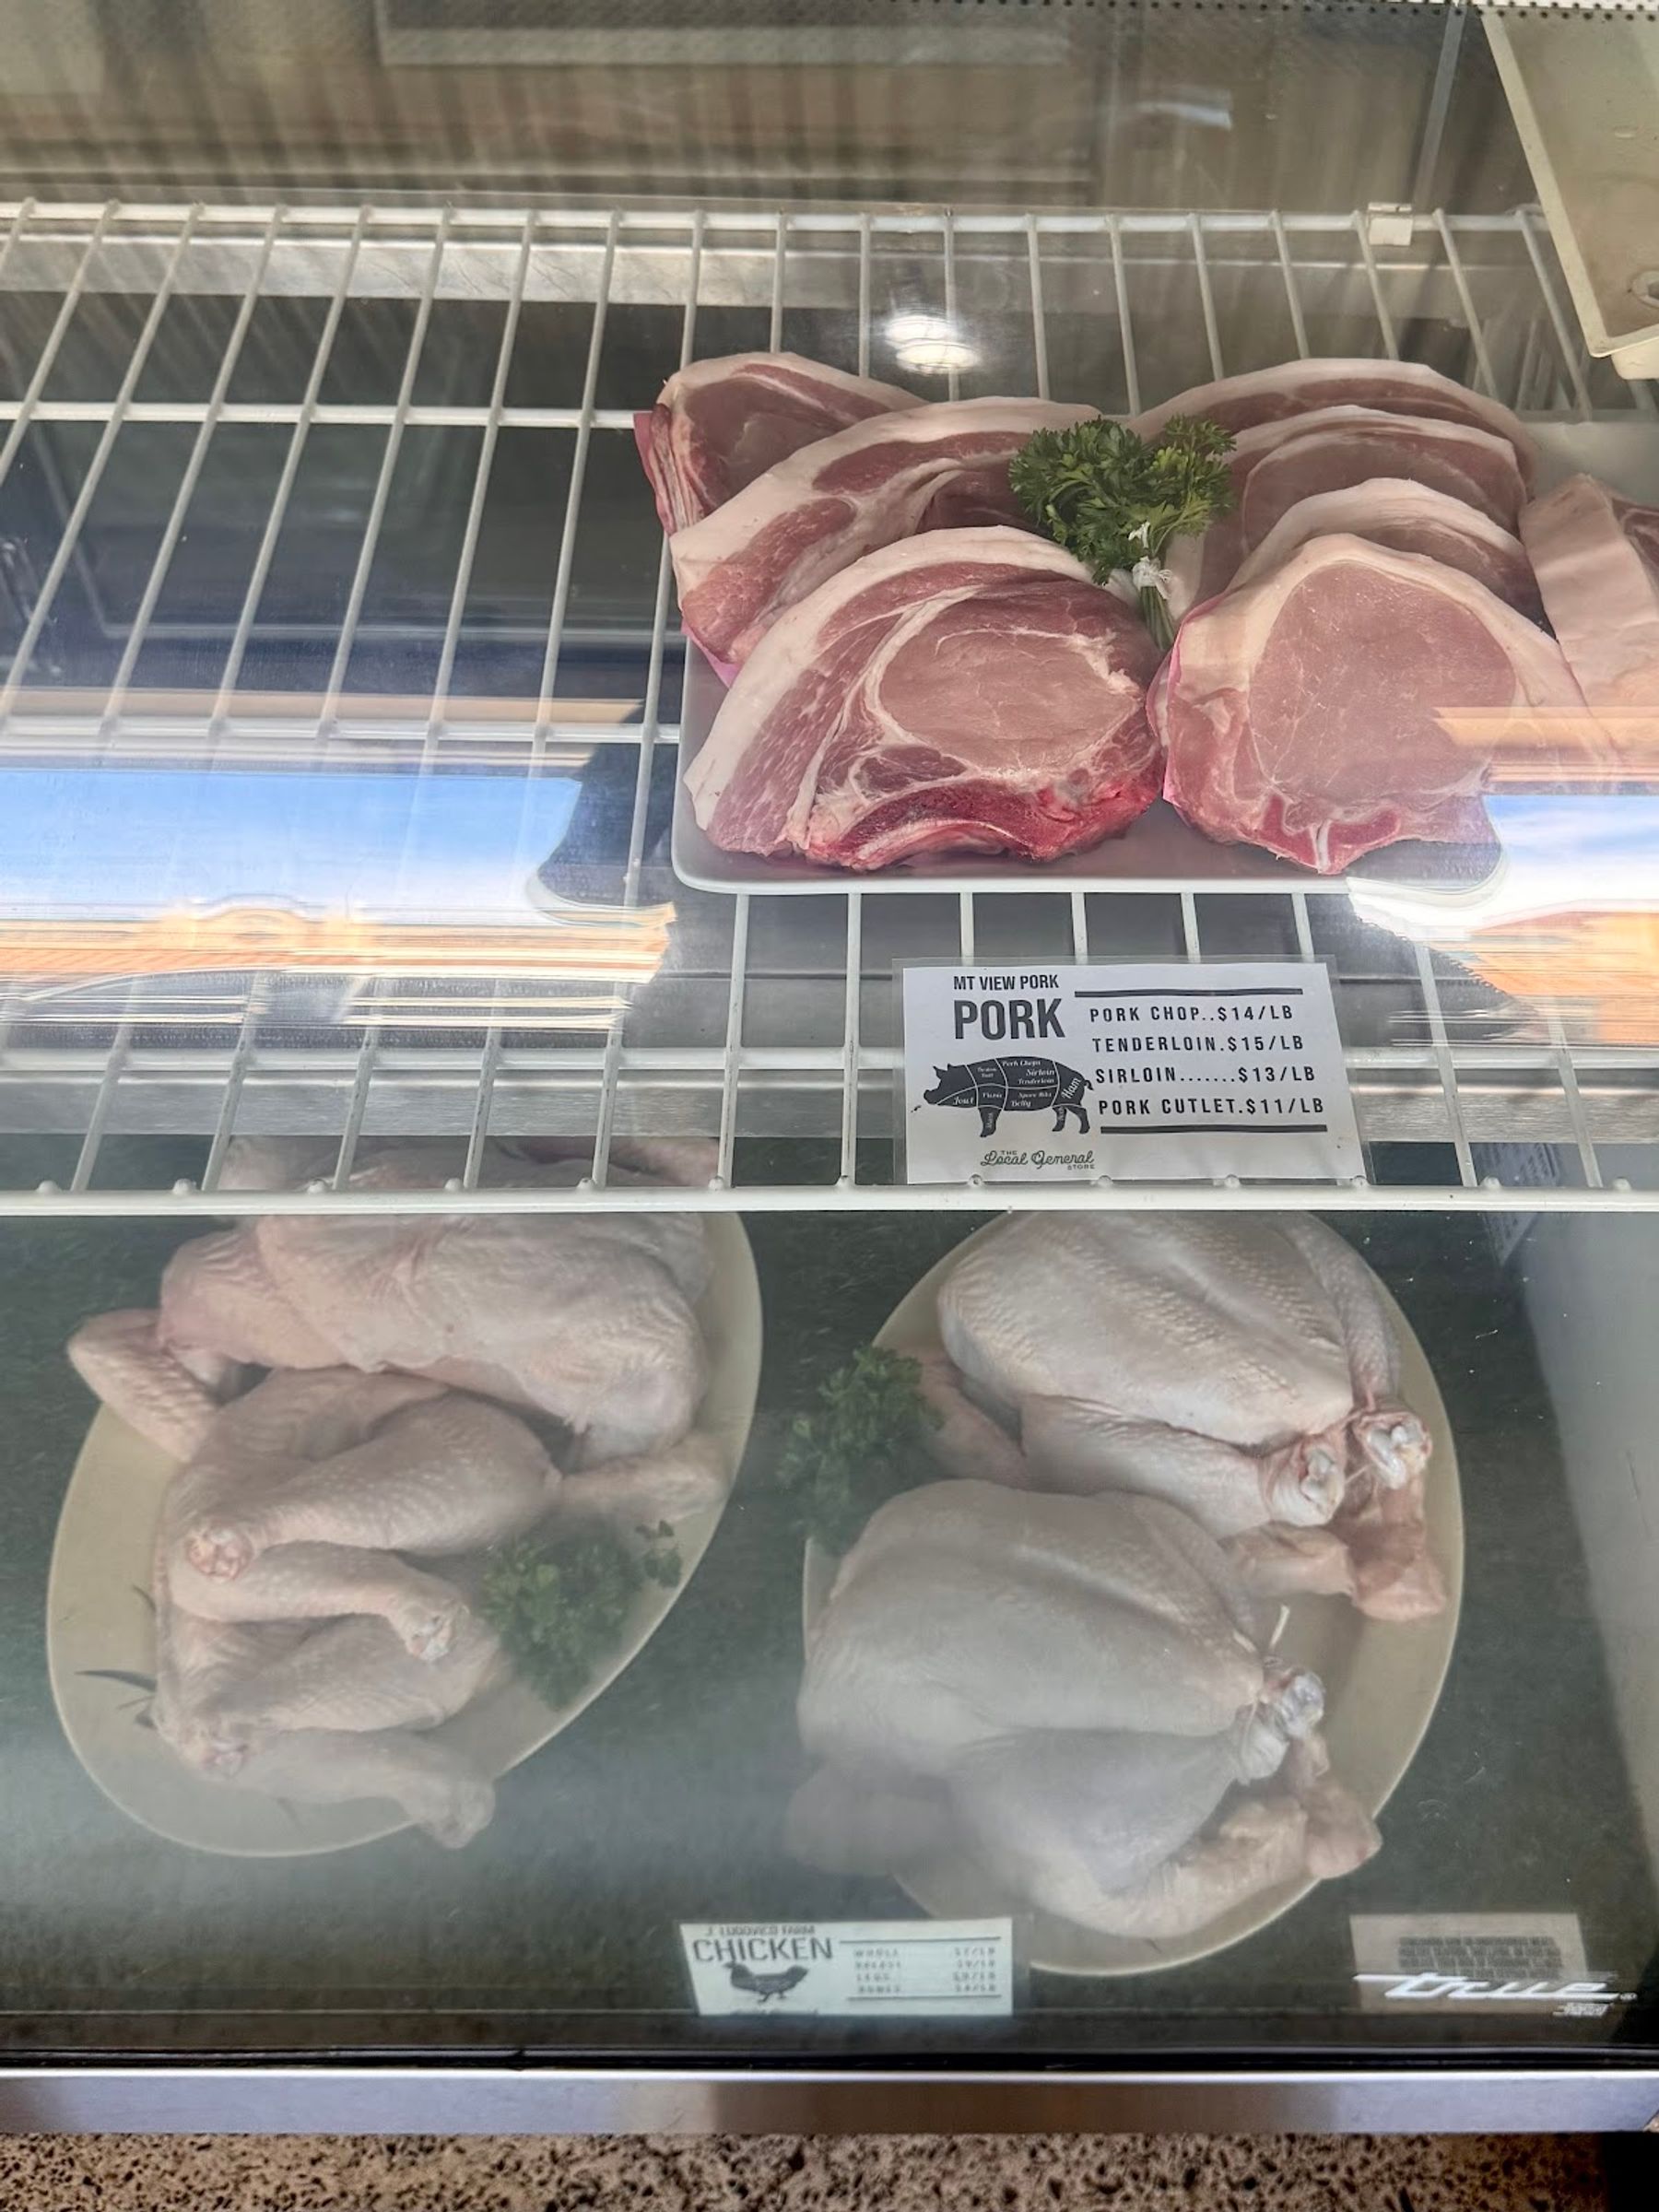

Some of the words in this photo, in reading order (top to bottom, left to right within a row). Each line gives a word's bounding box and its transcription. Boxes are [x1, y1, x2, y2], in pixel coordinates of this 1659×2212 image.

[953, 975, 975, 990] MT
[979, 975, 1016, 991] VIEW
[1019, 974, 1059, 990] PORK
[953, 998, 1065, 1041] PORK
[1089, 1006, 1141, 1023] PORK
[1061, 1077, 1082, 1100] Ham
[1099, 1099, 1151, 1116] PORK
[980, 1150, 1029, 1166] Local
[1030, 1150, 1095, 1170] General
[693, 1937, 833, 1962] CHICKEN
